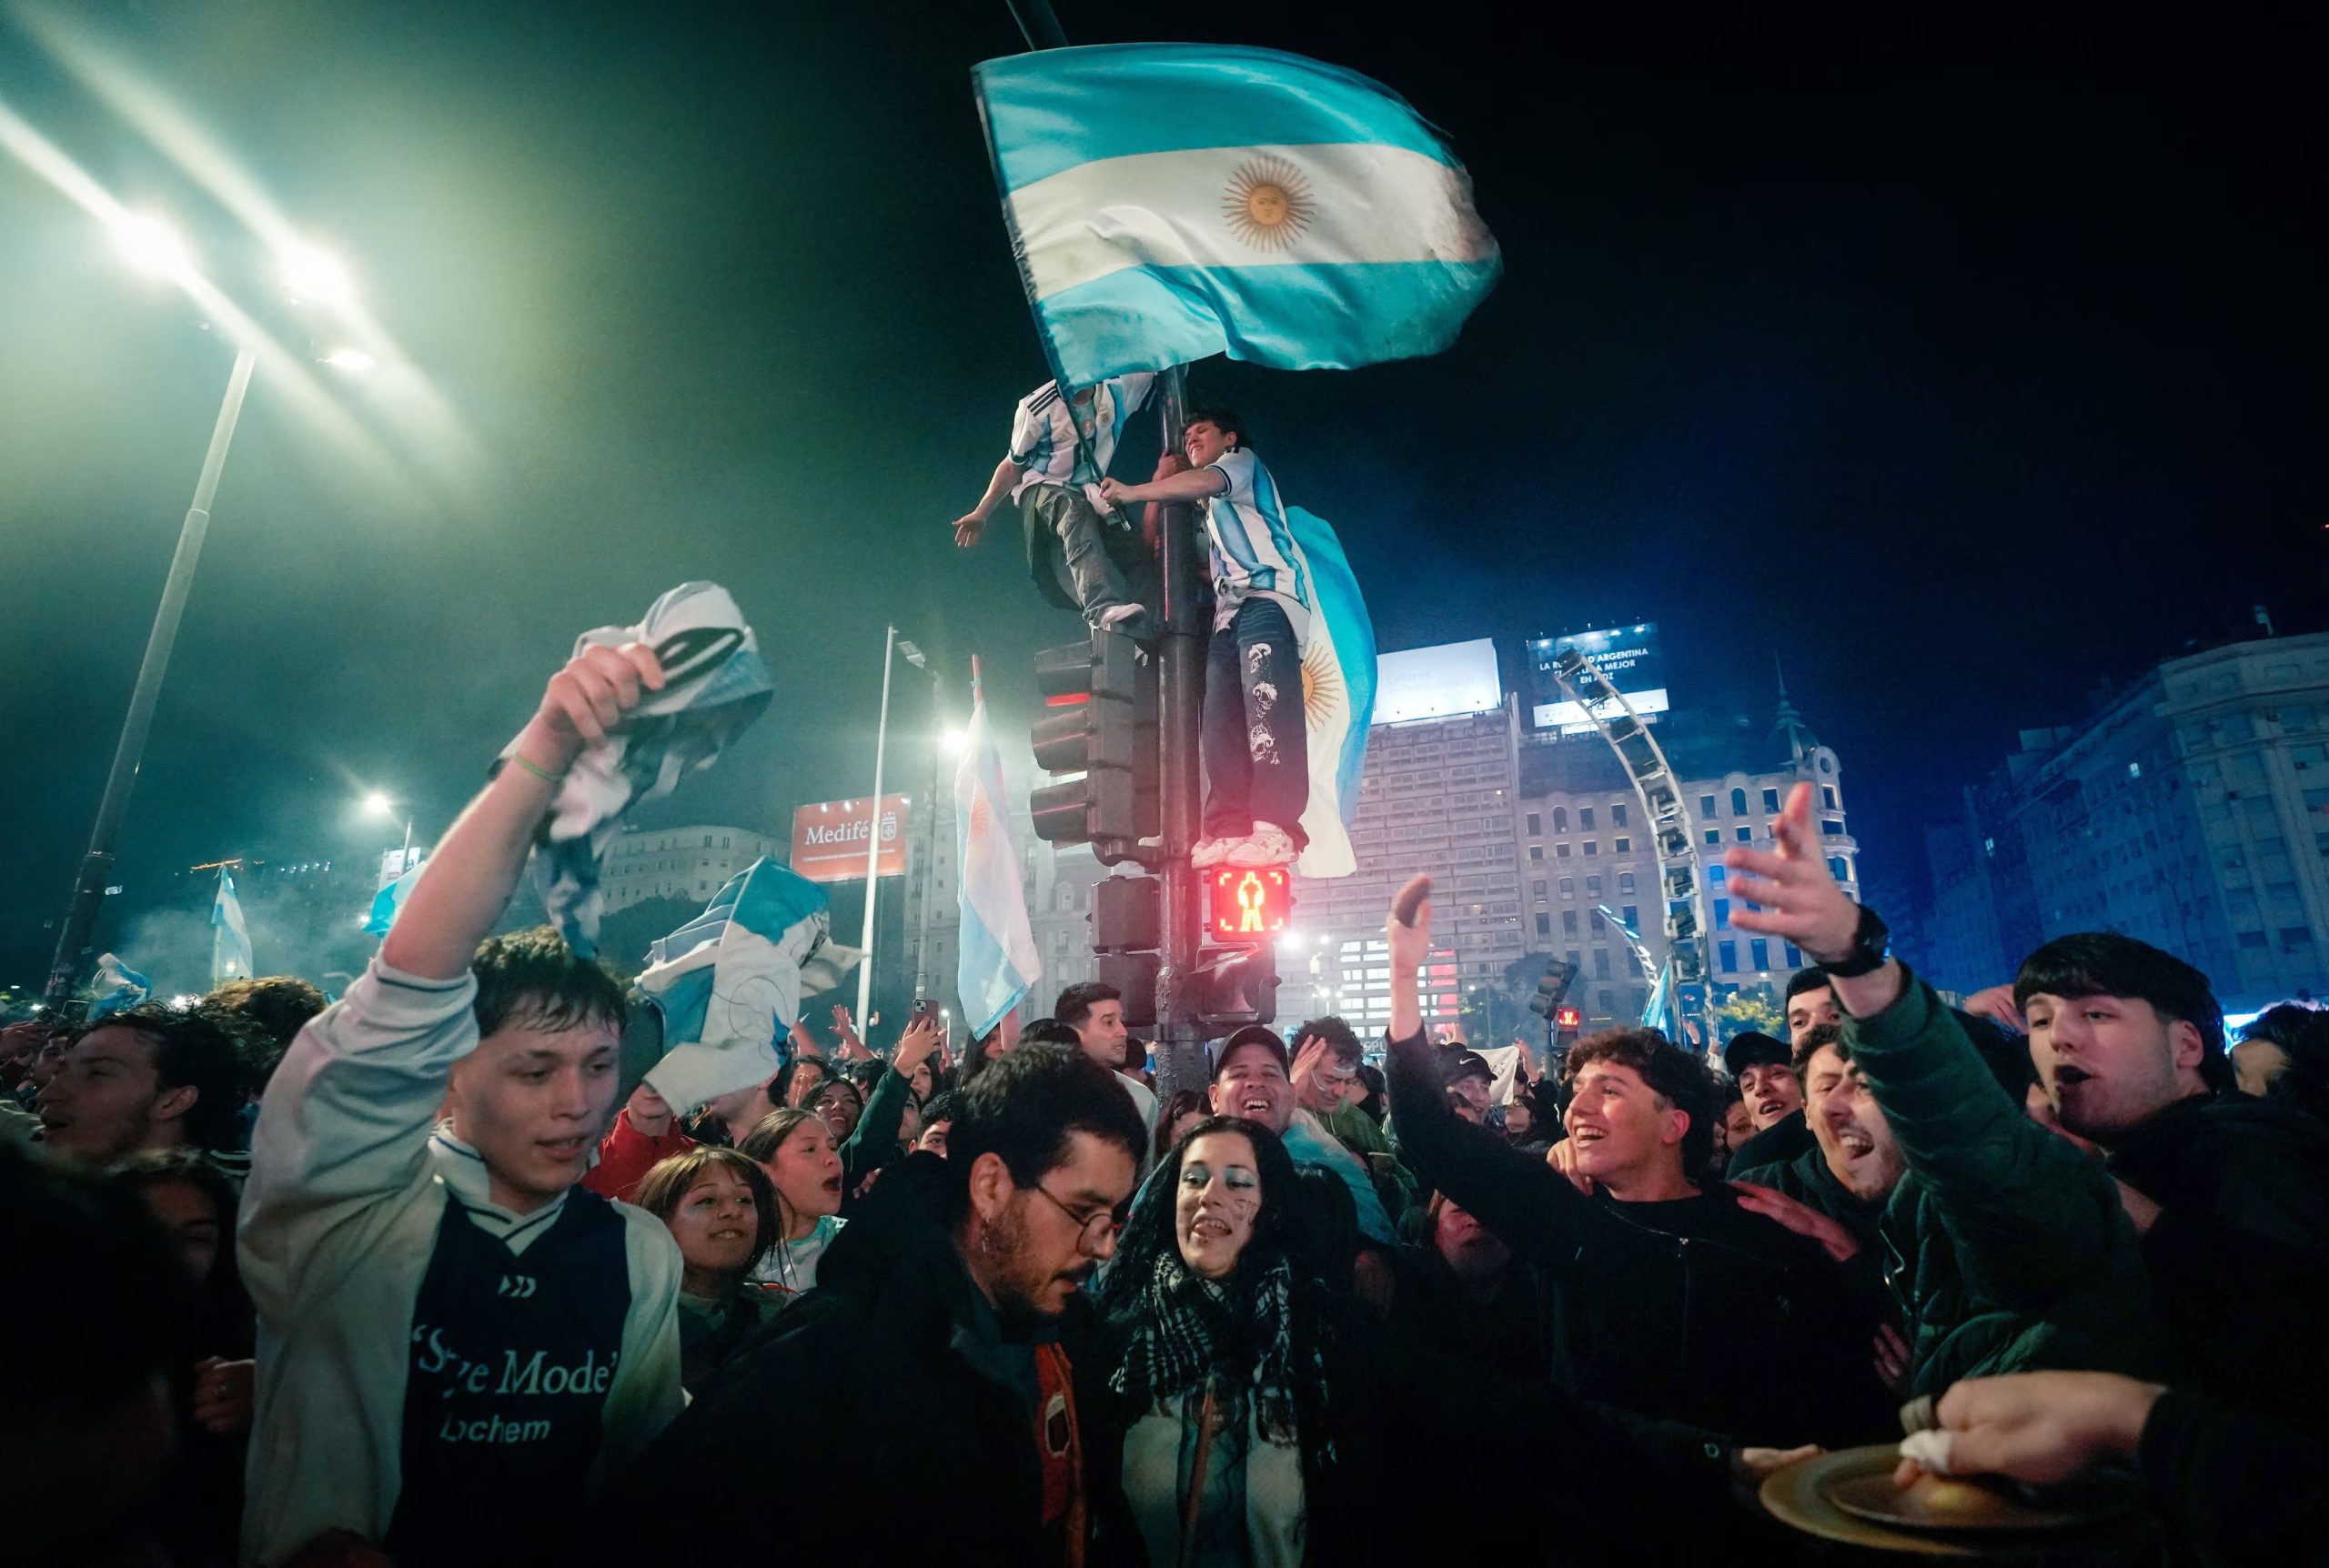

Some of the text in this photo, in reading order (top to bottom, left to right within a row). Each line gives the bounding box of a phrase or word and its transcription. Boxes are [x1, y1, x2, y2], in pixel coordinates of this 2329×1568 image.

[1539, 662, 1550, 671] LA
[1597, 648, 1648, 661] ARGENTINA
[1605, 659, 1636, 671] MEJOR
[1579, 674, 1592, 684] EN
[804, 820, 870, 846] Medifé
